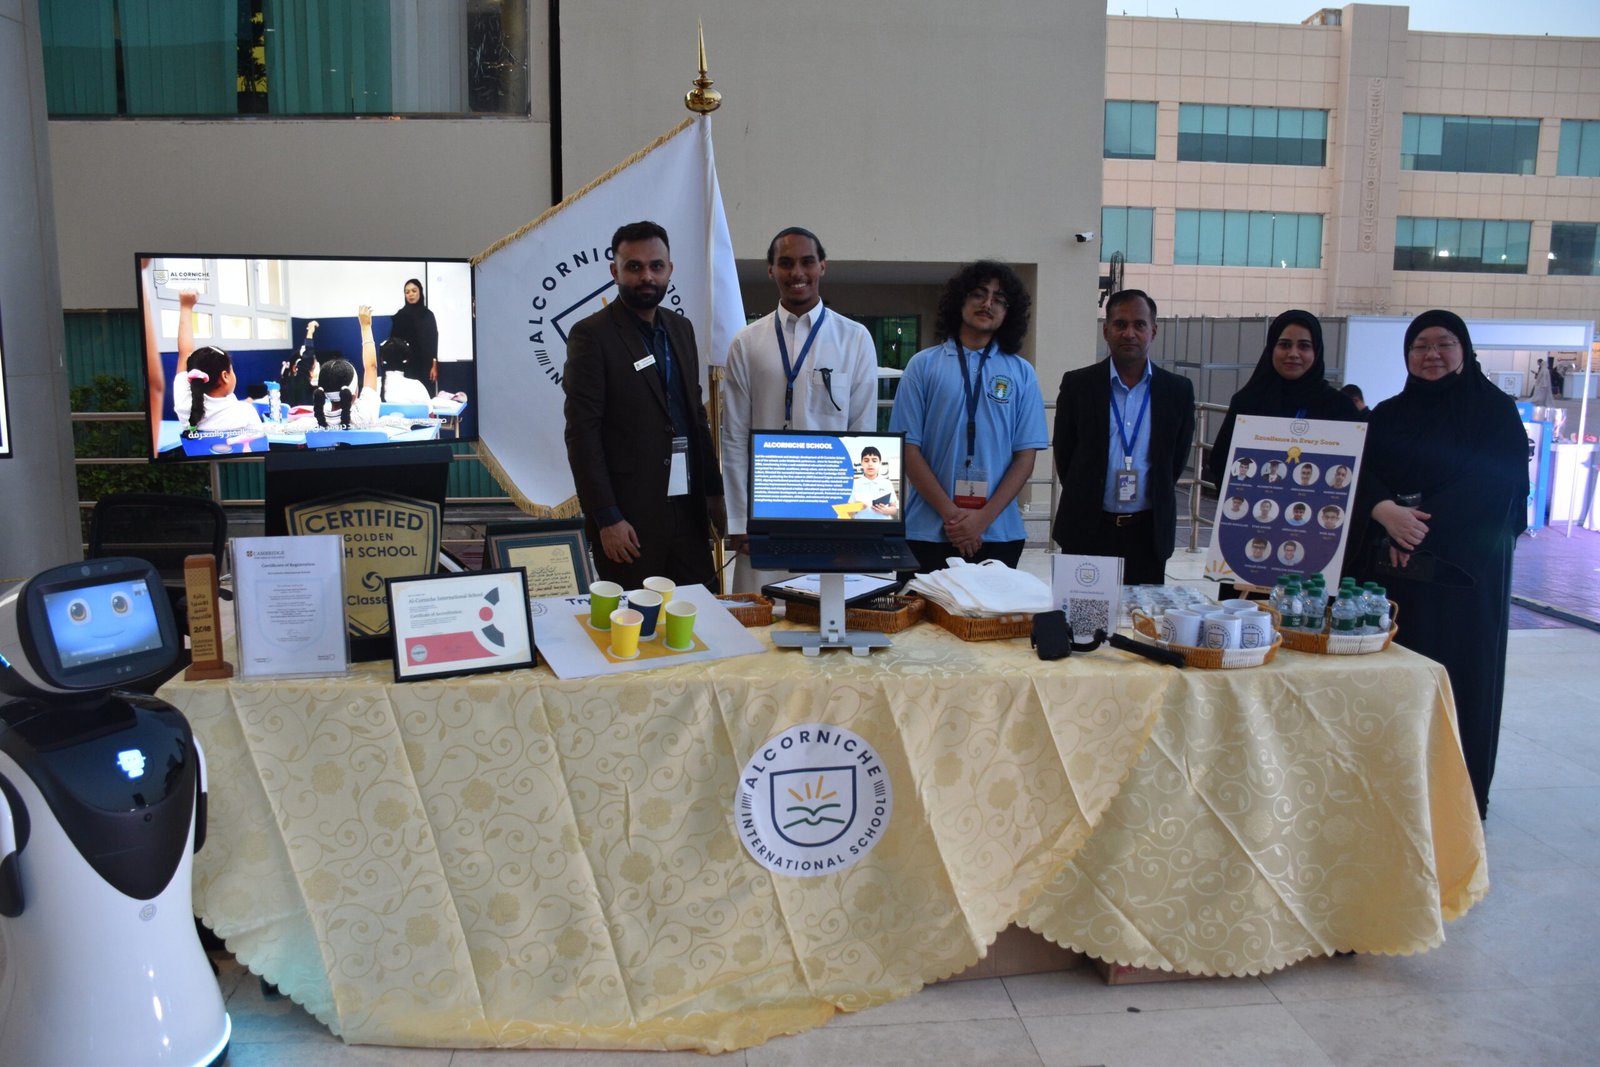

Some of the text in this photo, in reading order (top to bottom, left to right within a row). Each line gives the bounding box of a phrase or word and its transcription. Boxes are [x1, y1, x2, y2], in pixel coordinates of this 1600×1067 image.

[1363, 78, 1382, 252] COLLEGE OF ENGINEERING
[806, 442, 833, 450] SCHOOL
[1254, 434, 1290, 443] Excellence
[1299, 437, 1319, 446] Every
[305, 509, 424, 533] CERTIFIED
[343, 532, 394, 542] GOLDEN
[358, 545, 418, 558] SCHOOL
[347, 594, 389, 606] Classe
[742, 798, 886, 871] INTERNATIONAL SCHOOL
